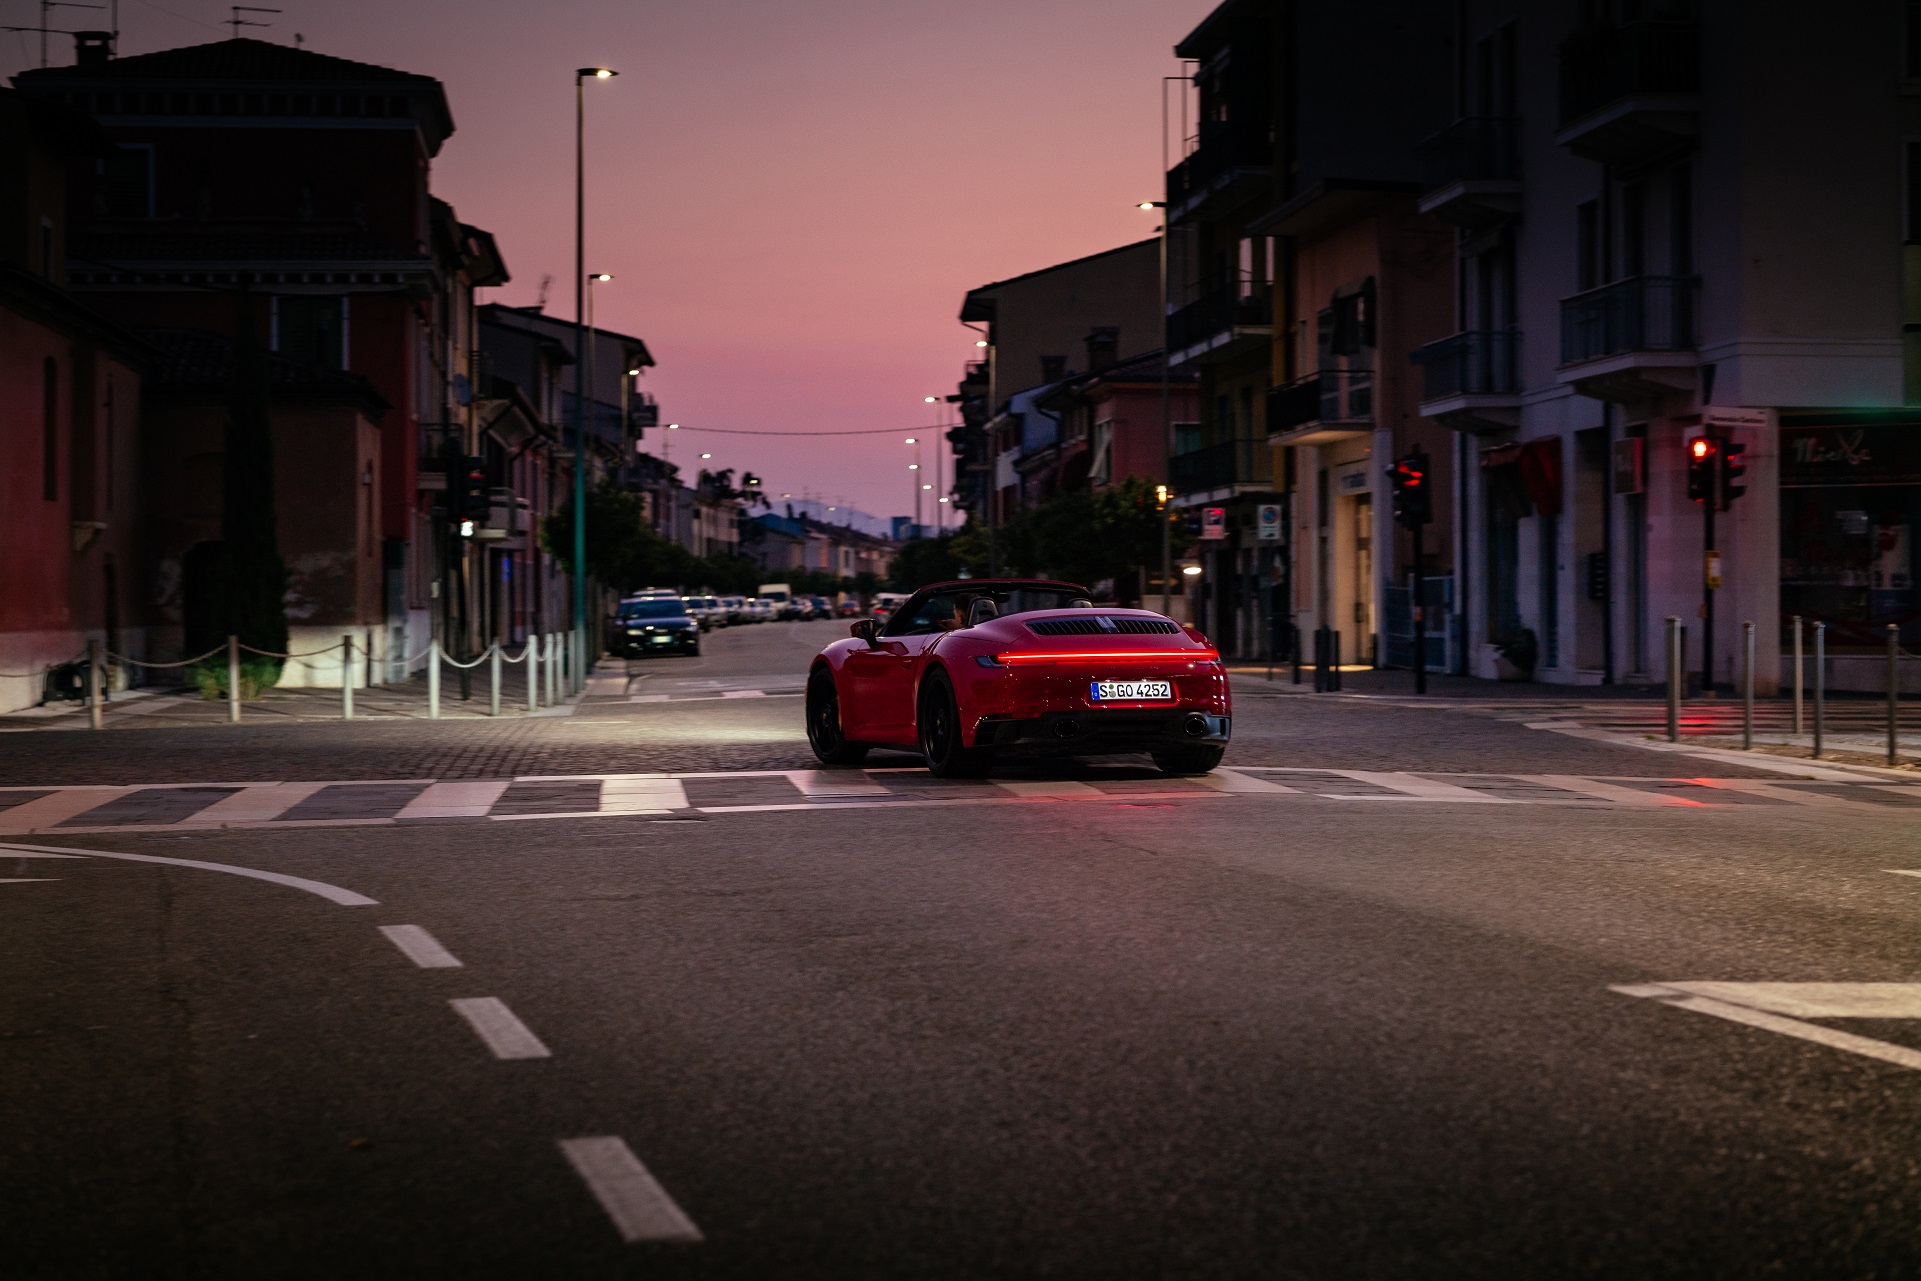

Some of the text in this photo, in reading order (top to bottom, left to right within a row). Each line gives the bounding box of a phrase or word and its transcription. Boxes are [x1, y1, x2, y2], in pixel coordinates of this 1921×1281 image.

[1100, 684, 1169, 697] S GO 4252
